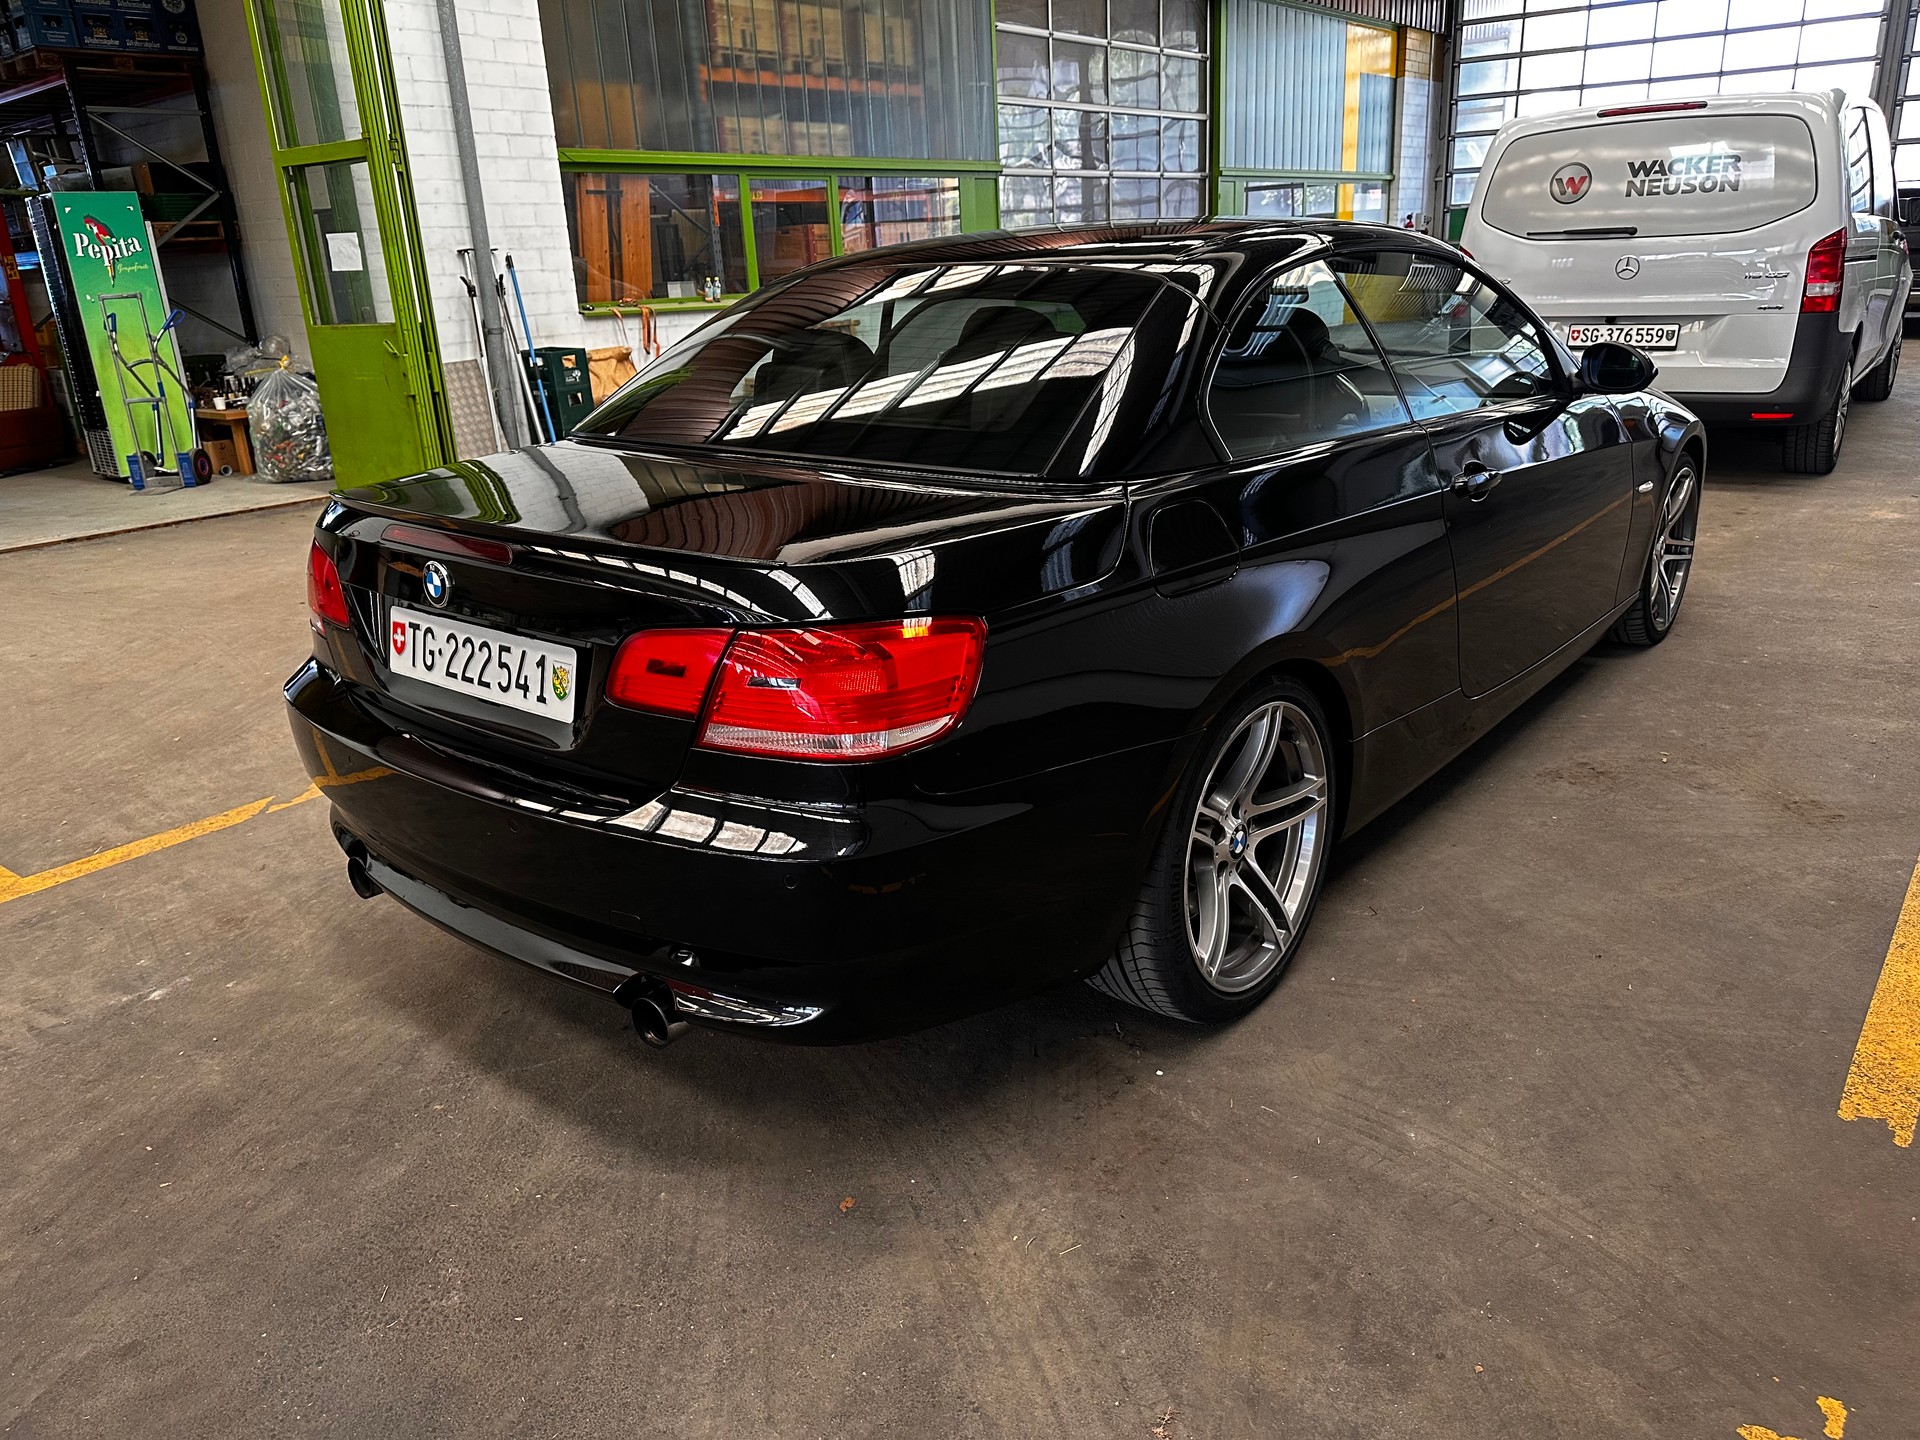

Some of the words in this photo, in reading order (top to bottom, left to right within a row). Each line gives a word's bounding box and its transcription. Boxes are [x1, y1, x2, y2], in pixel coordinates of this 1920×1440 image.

[1627, 155, 1741, 178] WACKER
[1625, 174, 1740, 197] NEUSON
[73, 233, 142, 267] Pepita
